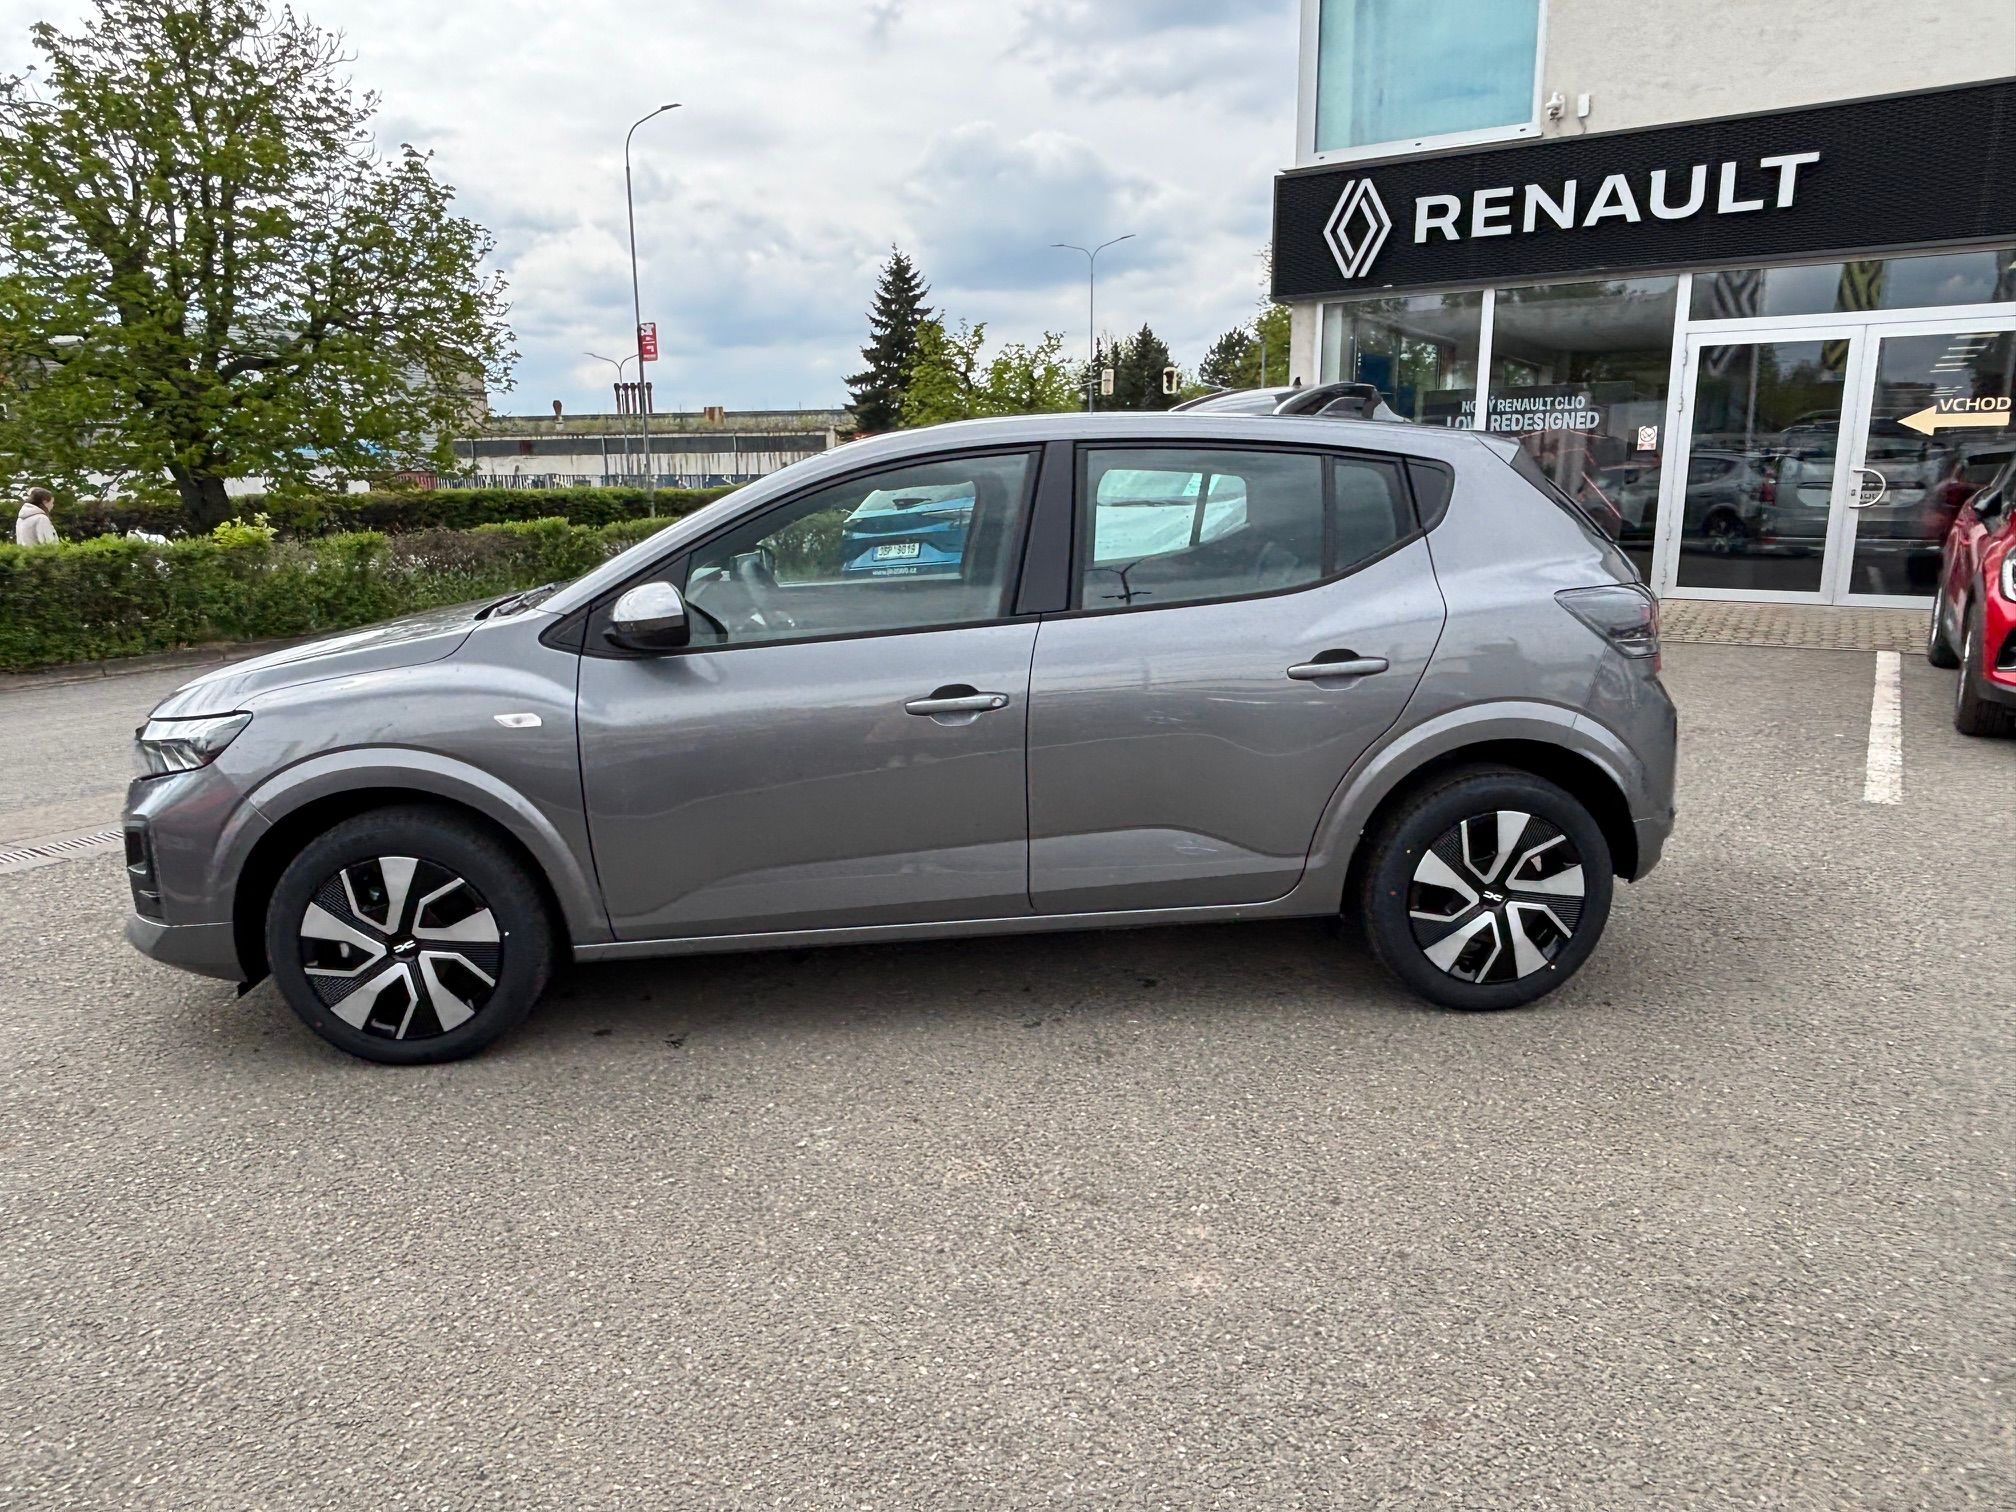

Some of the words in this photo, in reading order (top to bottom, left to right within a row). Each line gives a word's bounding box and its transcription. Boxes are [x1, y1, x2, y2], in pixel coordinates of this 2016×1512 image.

[1413, 151, 1820, 243] RENAULT
[1461, 395, 1496, 413] NOÝ
[1497, 397, 1554, 412] RENAULT
[1554, 395, 1586, 410] CLIO
[1939, 396, 2012, 412] VCHOD
[1490, 411, 1600, 432] REDESIGNED
